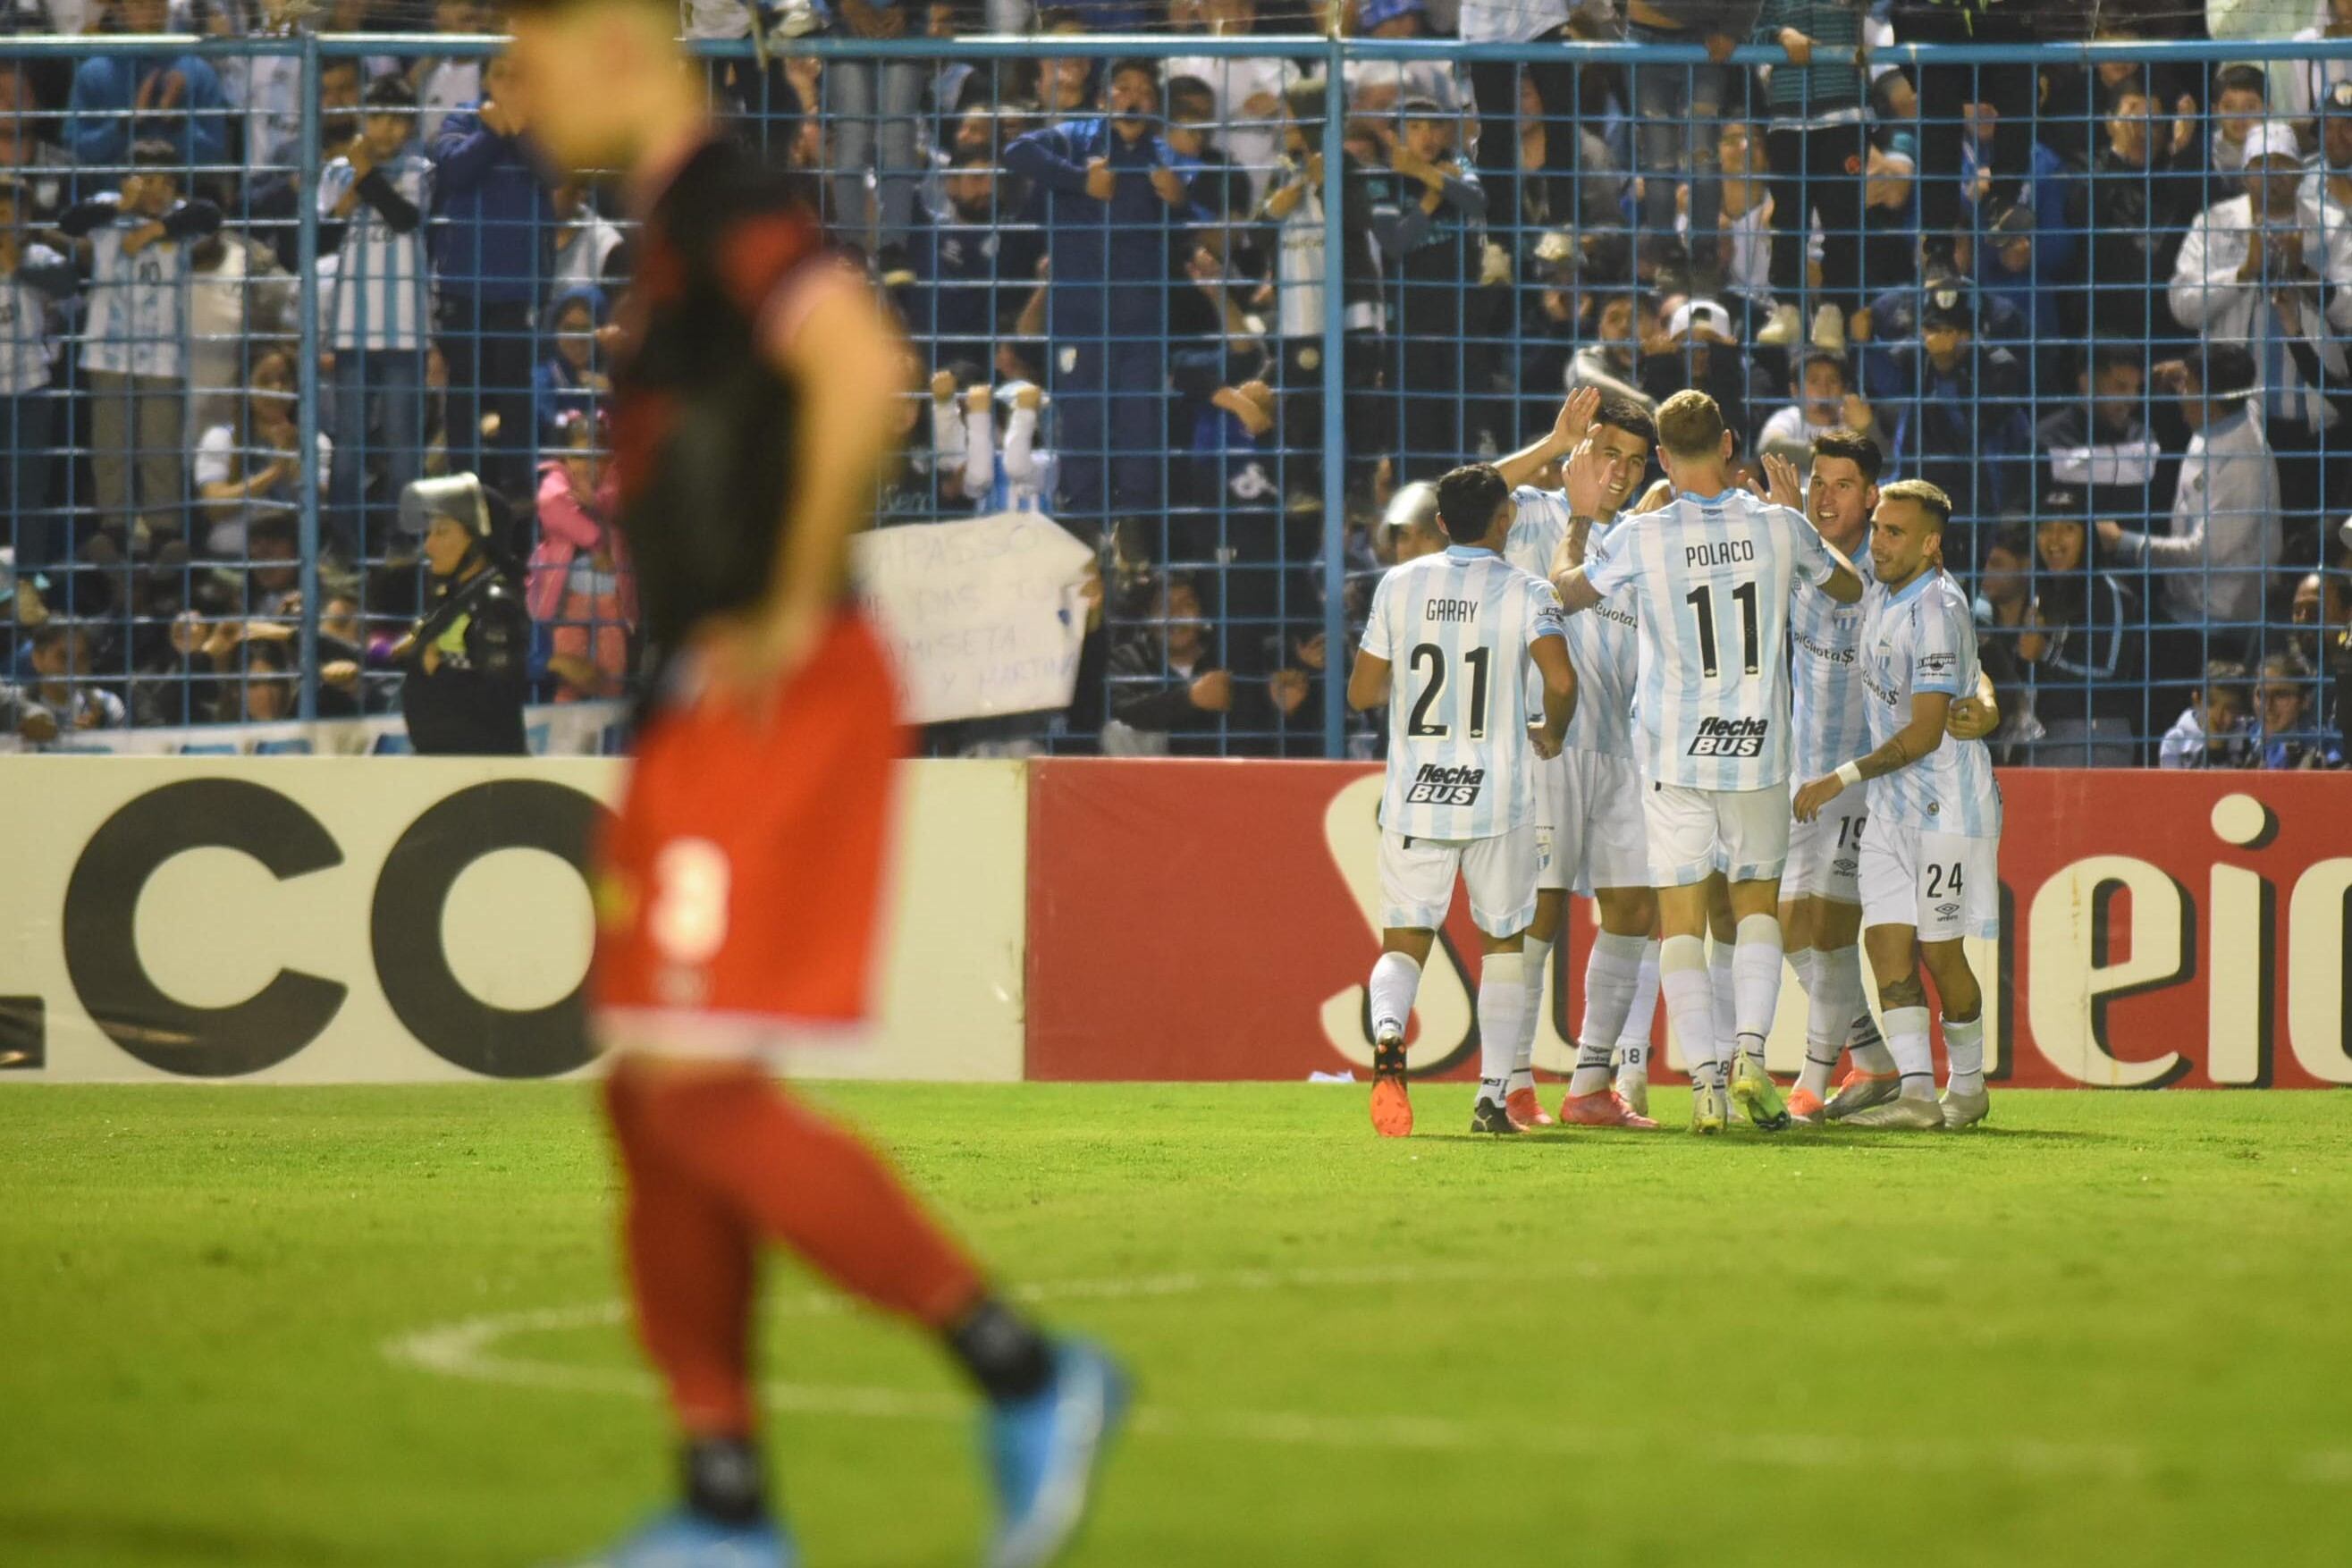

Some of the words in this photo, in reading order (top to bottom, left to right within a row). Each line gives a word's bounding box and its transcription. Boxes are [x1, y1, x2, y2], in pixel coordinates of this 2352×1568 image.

[1685, 539, 1755, 569] POLACO
[1426, 599, 1479, 623] GARAY
[1686, 581, 1760, 679] 11
[1408, 643, 1492, 741] 21
[1697, 716, 1769, 737] flecha
[1690, 736, 1763, 757] BUS
[1415, 763, 1486, 786] flecha
[1408, 784, 1478, 805] BUS
[1926, 862, 1964, 898] 24
[1621, 1048, 1640, 1066] 18
